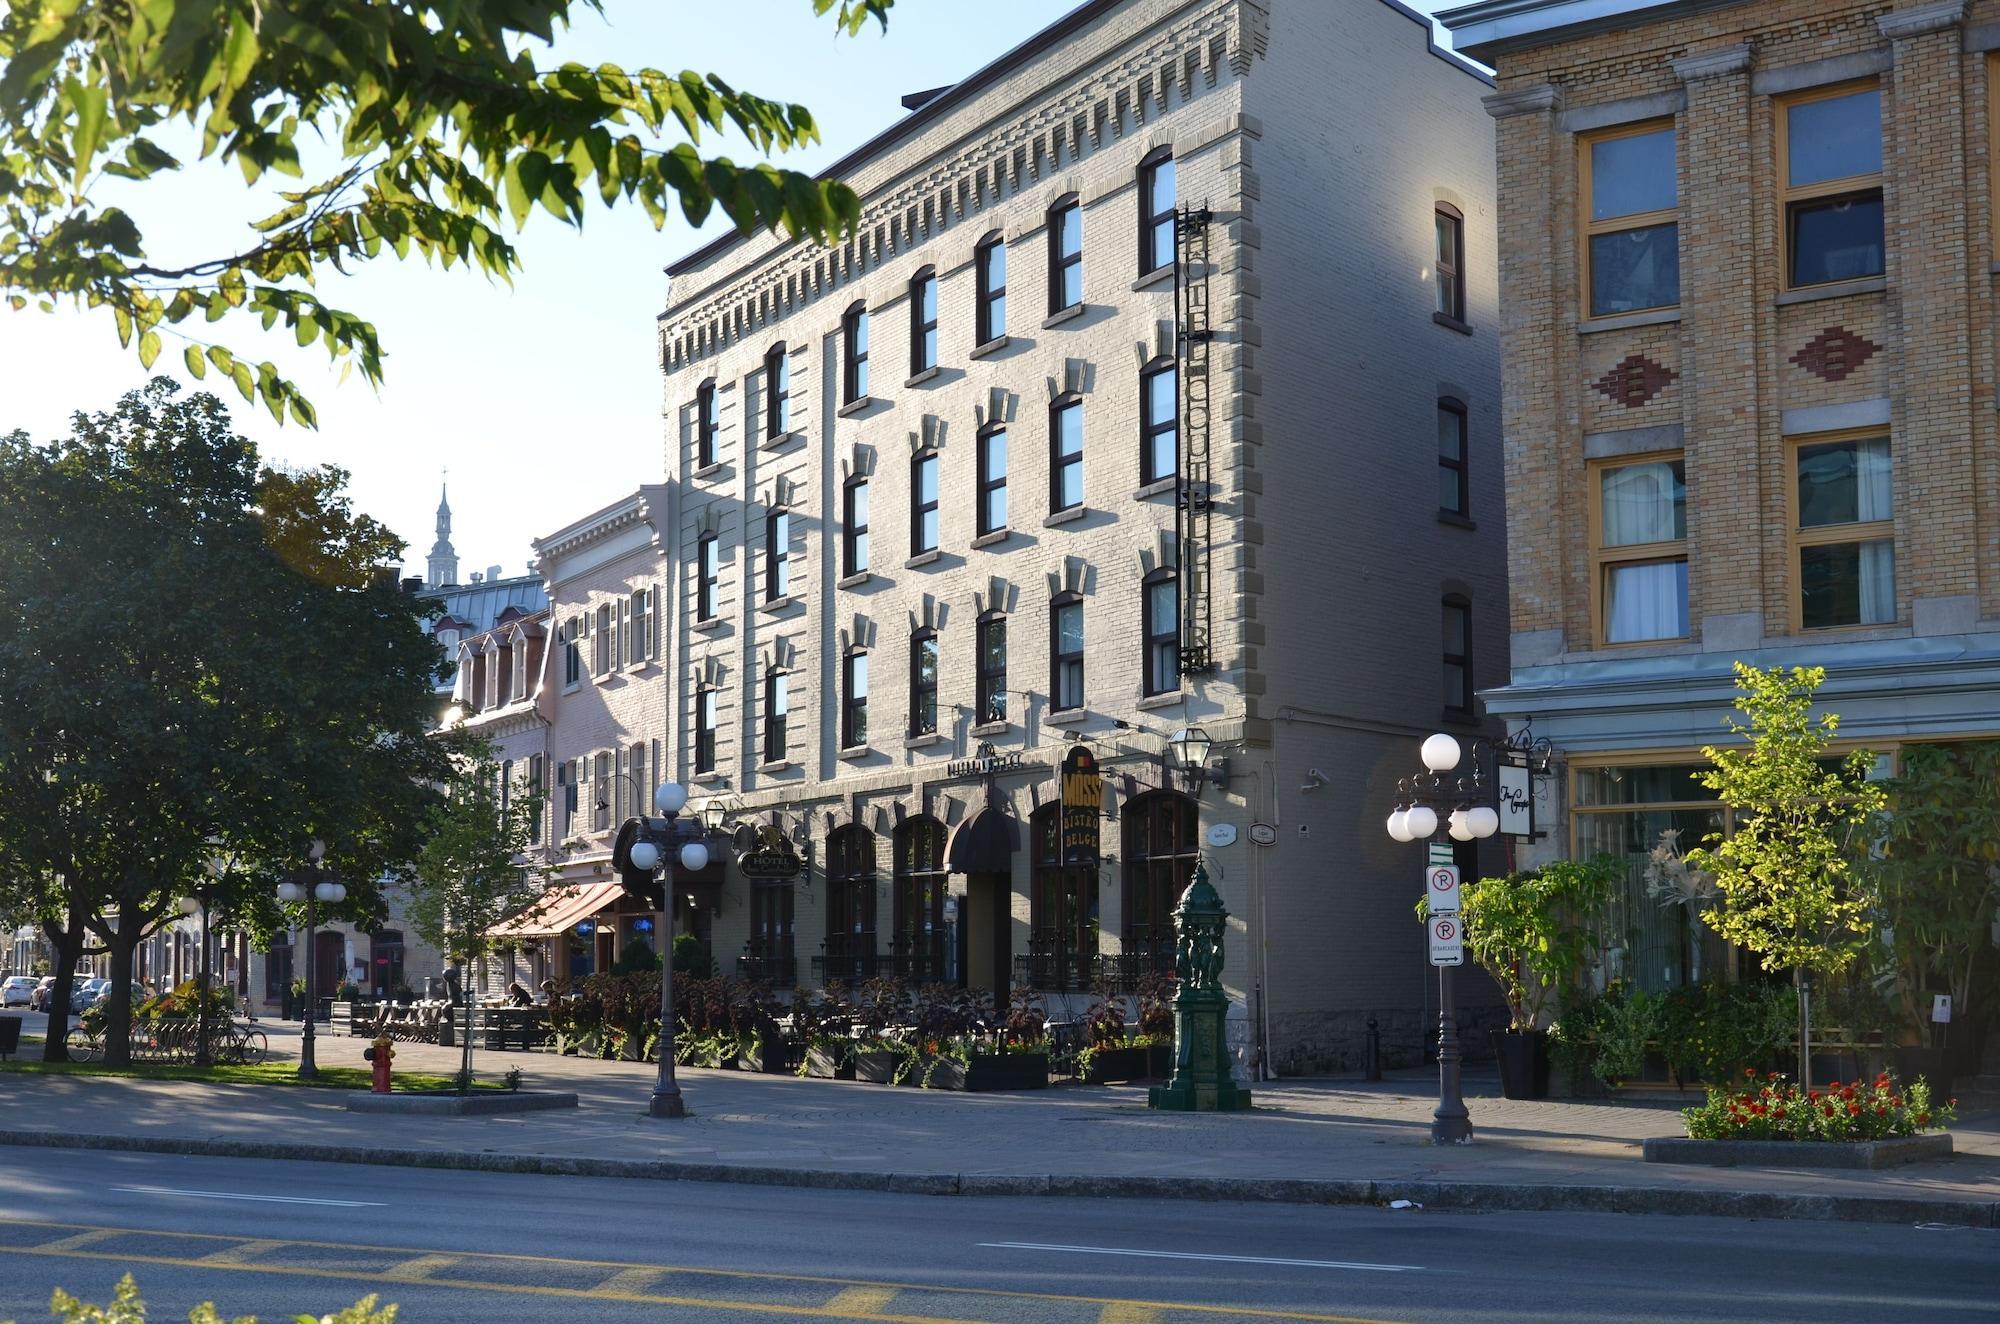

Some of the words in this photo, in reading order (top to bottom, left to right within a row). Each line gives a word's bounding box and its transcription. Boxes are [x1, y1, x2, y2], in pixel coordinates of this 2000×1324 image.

[1063, 773, 1100, 808] MOSS
[1064, 814, 1098, 829] BISTRO
[1066, 832, 1097, 848] BELGE
